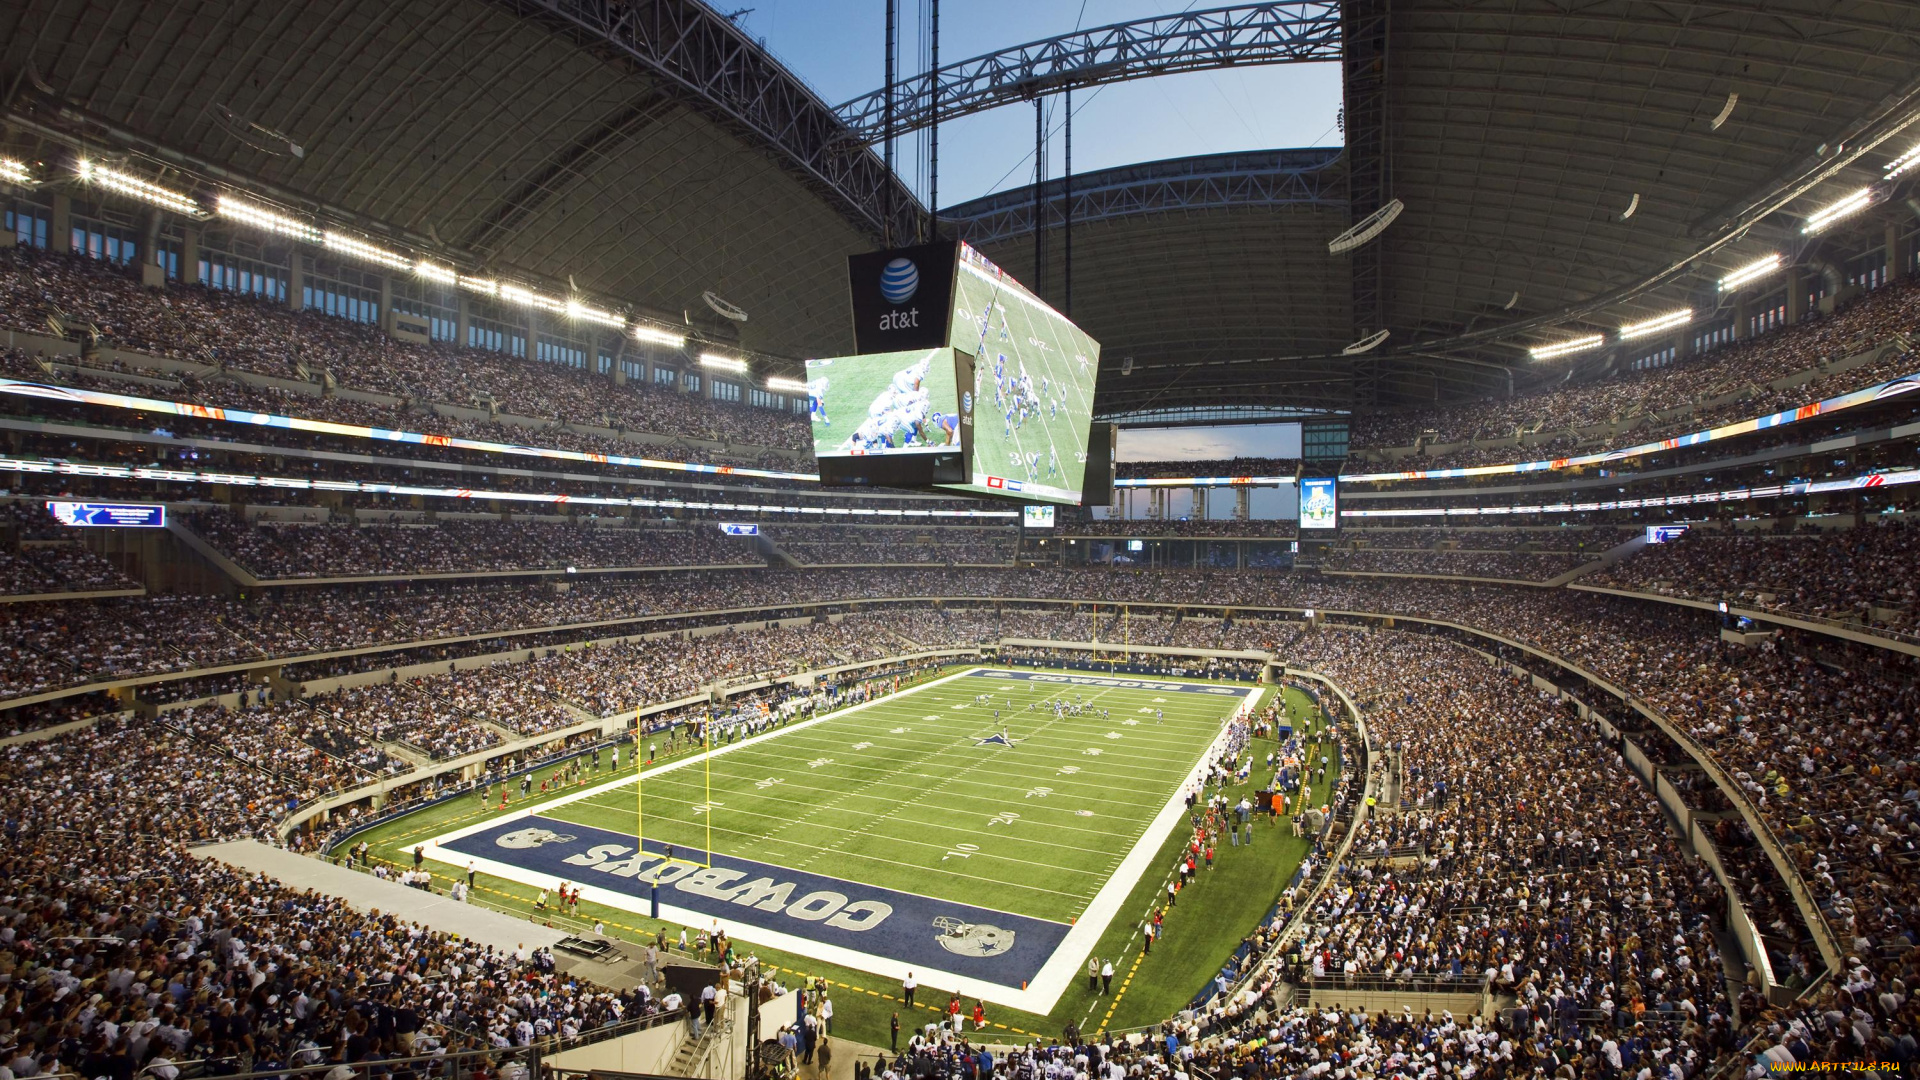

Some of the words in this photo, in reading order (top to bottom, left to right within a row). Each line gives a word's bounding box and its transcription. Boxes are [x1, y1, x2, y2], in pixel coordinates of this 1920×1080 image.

[879, 307, 919, 331] at&t
[990, 811, 1020, 825] 20
[946, 843, 980, 859] 10
[561, 843, 893, 932] COWBOYS
